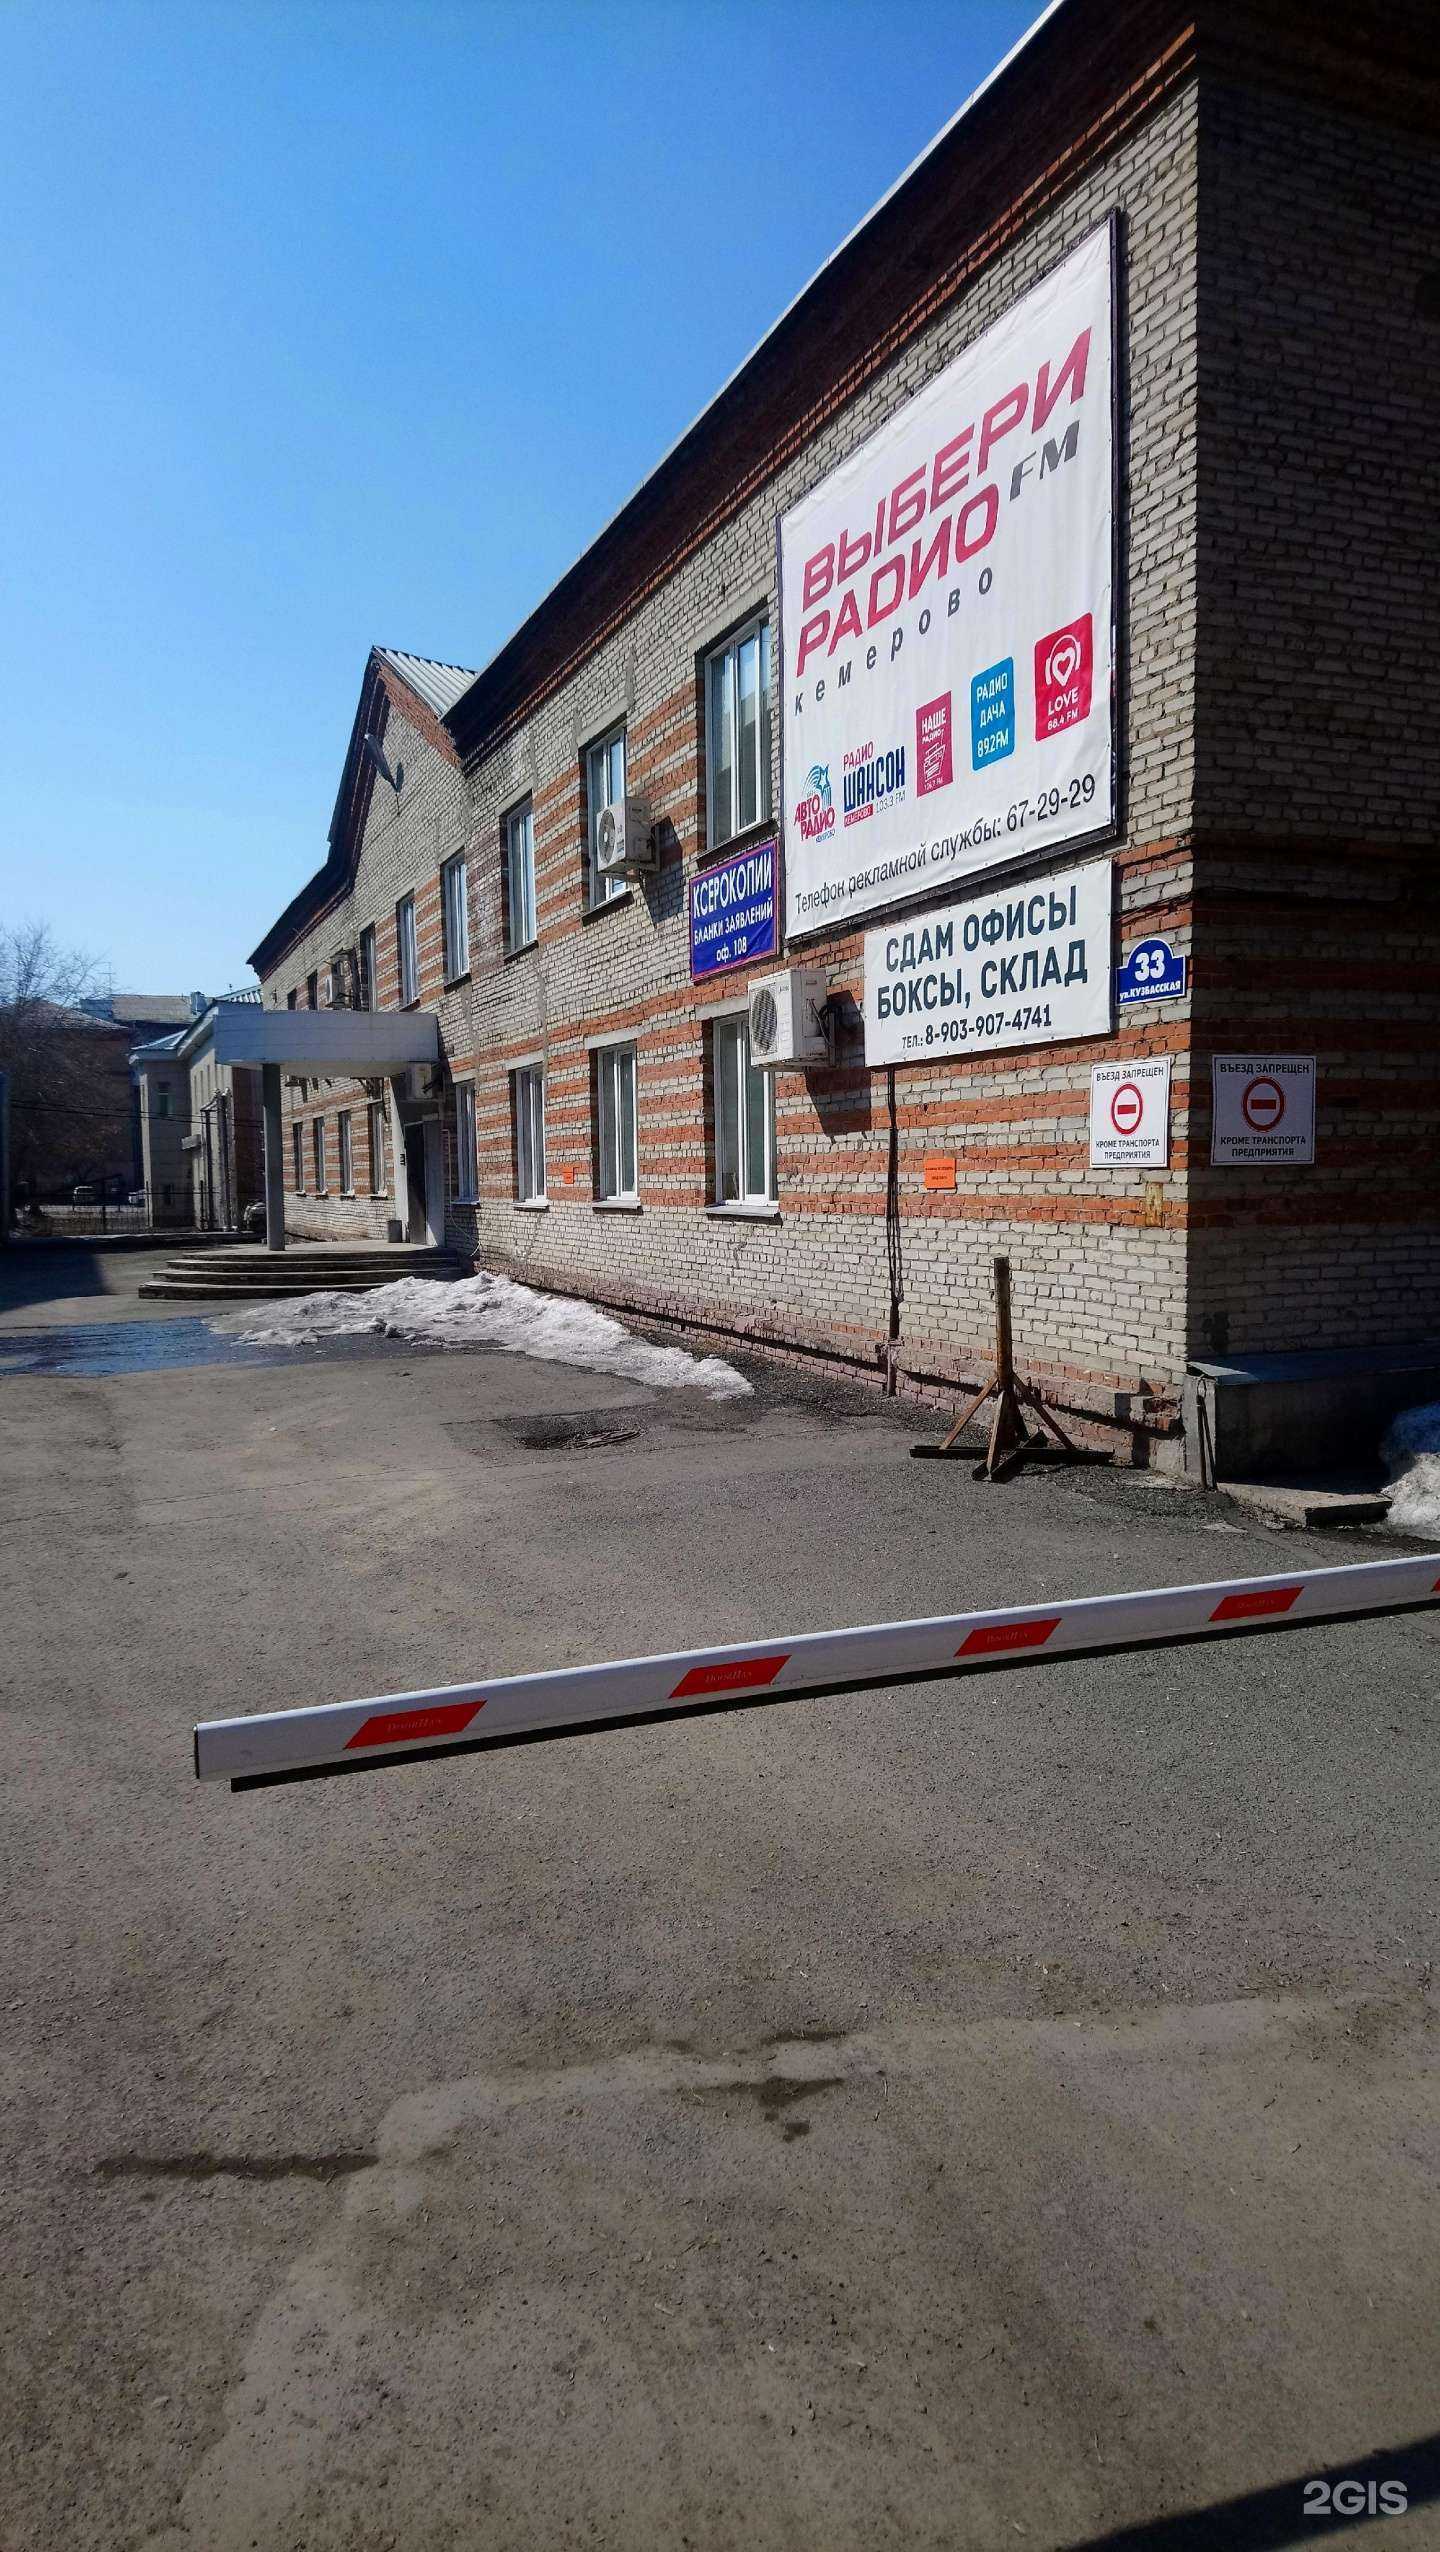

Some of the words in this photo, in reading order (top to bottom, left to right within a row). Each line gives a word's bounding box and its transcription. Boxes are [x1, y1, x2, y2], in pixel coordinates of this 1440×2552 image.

[802, 326, 1091, 612] ВЫБЕРИ
[1009, 420, 1080, 502] FM
[976, 672, 1008, 703] РАДИО
[1048, 687, 1079, 716] LOVE
[921, 708, 946, 736] НАШЕ
[980, 700, 1006, 728] ДАЧА
[1047, 714, 1065, 731] 88.4
[1066, 708, 1079, 721] FM
[844, 741, 873, 771] РАДИО
[843, 745, 905, 813] ШАНСОН
[793, 794, 820, 826] АВТО
[876, 795, 894, 813] 103.3
[800, 806, 835, 841] РАДИО
[795, 878, 845, 915] Телефон
[848, 841, 927, 898] рекламной
[931, 817, 1001, 860] службы:
[1006, 773, 1095, 832] 67-29-29
[693, 852, 772, 919] КСЕРОКОПИИ
[694, 922, 723, 945] БЛАНКИ
[725, 898, 773, 934] ЗАЯВЛЕНИЙ
[886, 921, 954, 973] СДАМ
[963, 885, 1077, 952] ОФИСЫ
[716, 942, 732, 962] оф.
[733, 936, 747, 956] 108
[877, 968, 971, 1020] БОКСЫ,
[980, 939, 1088, 998] СКЛАД
[1134, 949, 1165, 981] 33
[902, 1036, 924, 1049] ТЕЛ.:
[925, 1004, 1052, 1046] 8-903-907-4741
[1096, 1071, 1120, 1082] ВЪЕЗД
[1121, 1067, 1164, 1080] ЗАПРЕЩЕН
[1220, 1063, 1254, 1075] ВЪЕЗД
[1255, 1063, 1310, 1076] ЗАПРЕЩЕН
[1096, 1140, 1117, 1149] КРОМЕ
[1118, 1139, 1160, 1149] ТРАНСПОРТА
[1220, 1136, 1250, 1145] КРОМЕ
[1252, 1135, 1306, 1145] ТРАНСПОРТА
[1231, 1148, 1295, 1158] ПРЕДПРИЯТИЯ
[1104, 1151, 1151, 1161] ПРЕДПРИЯТИЯ
